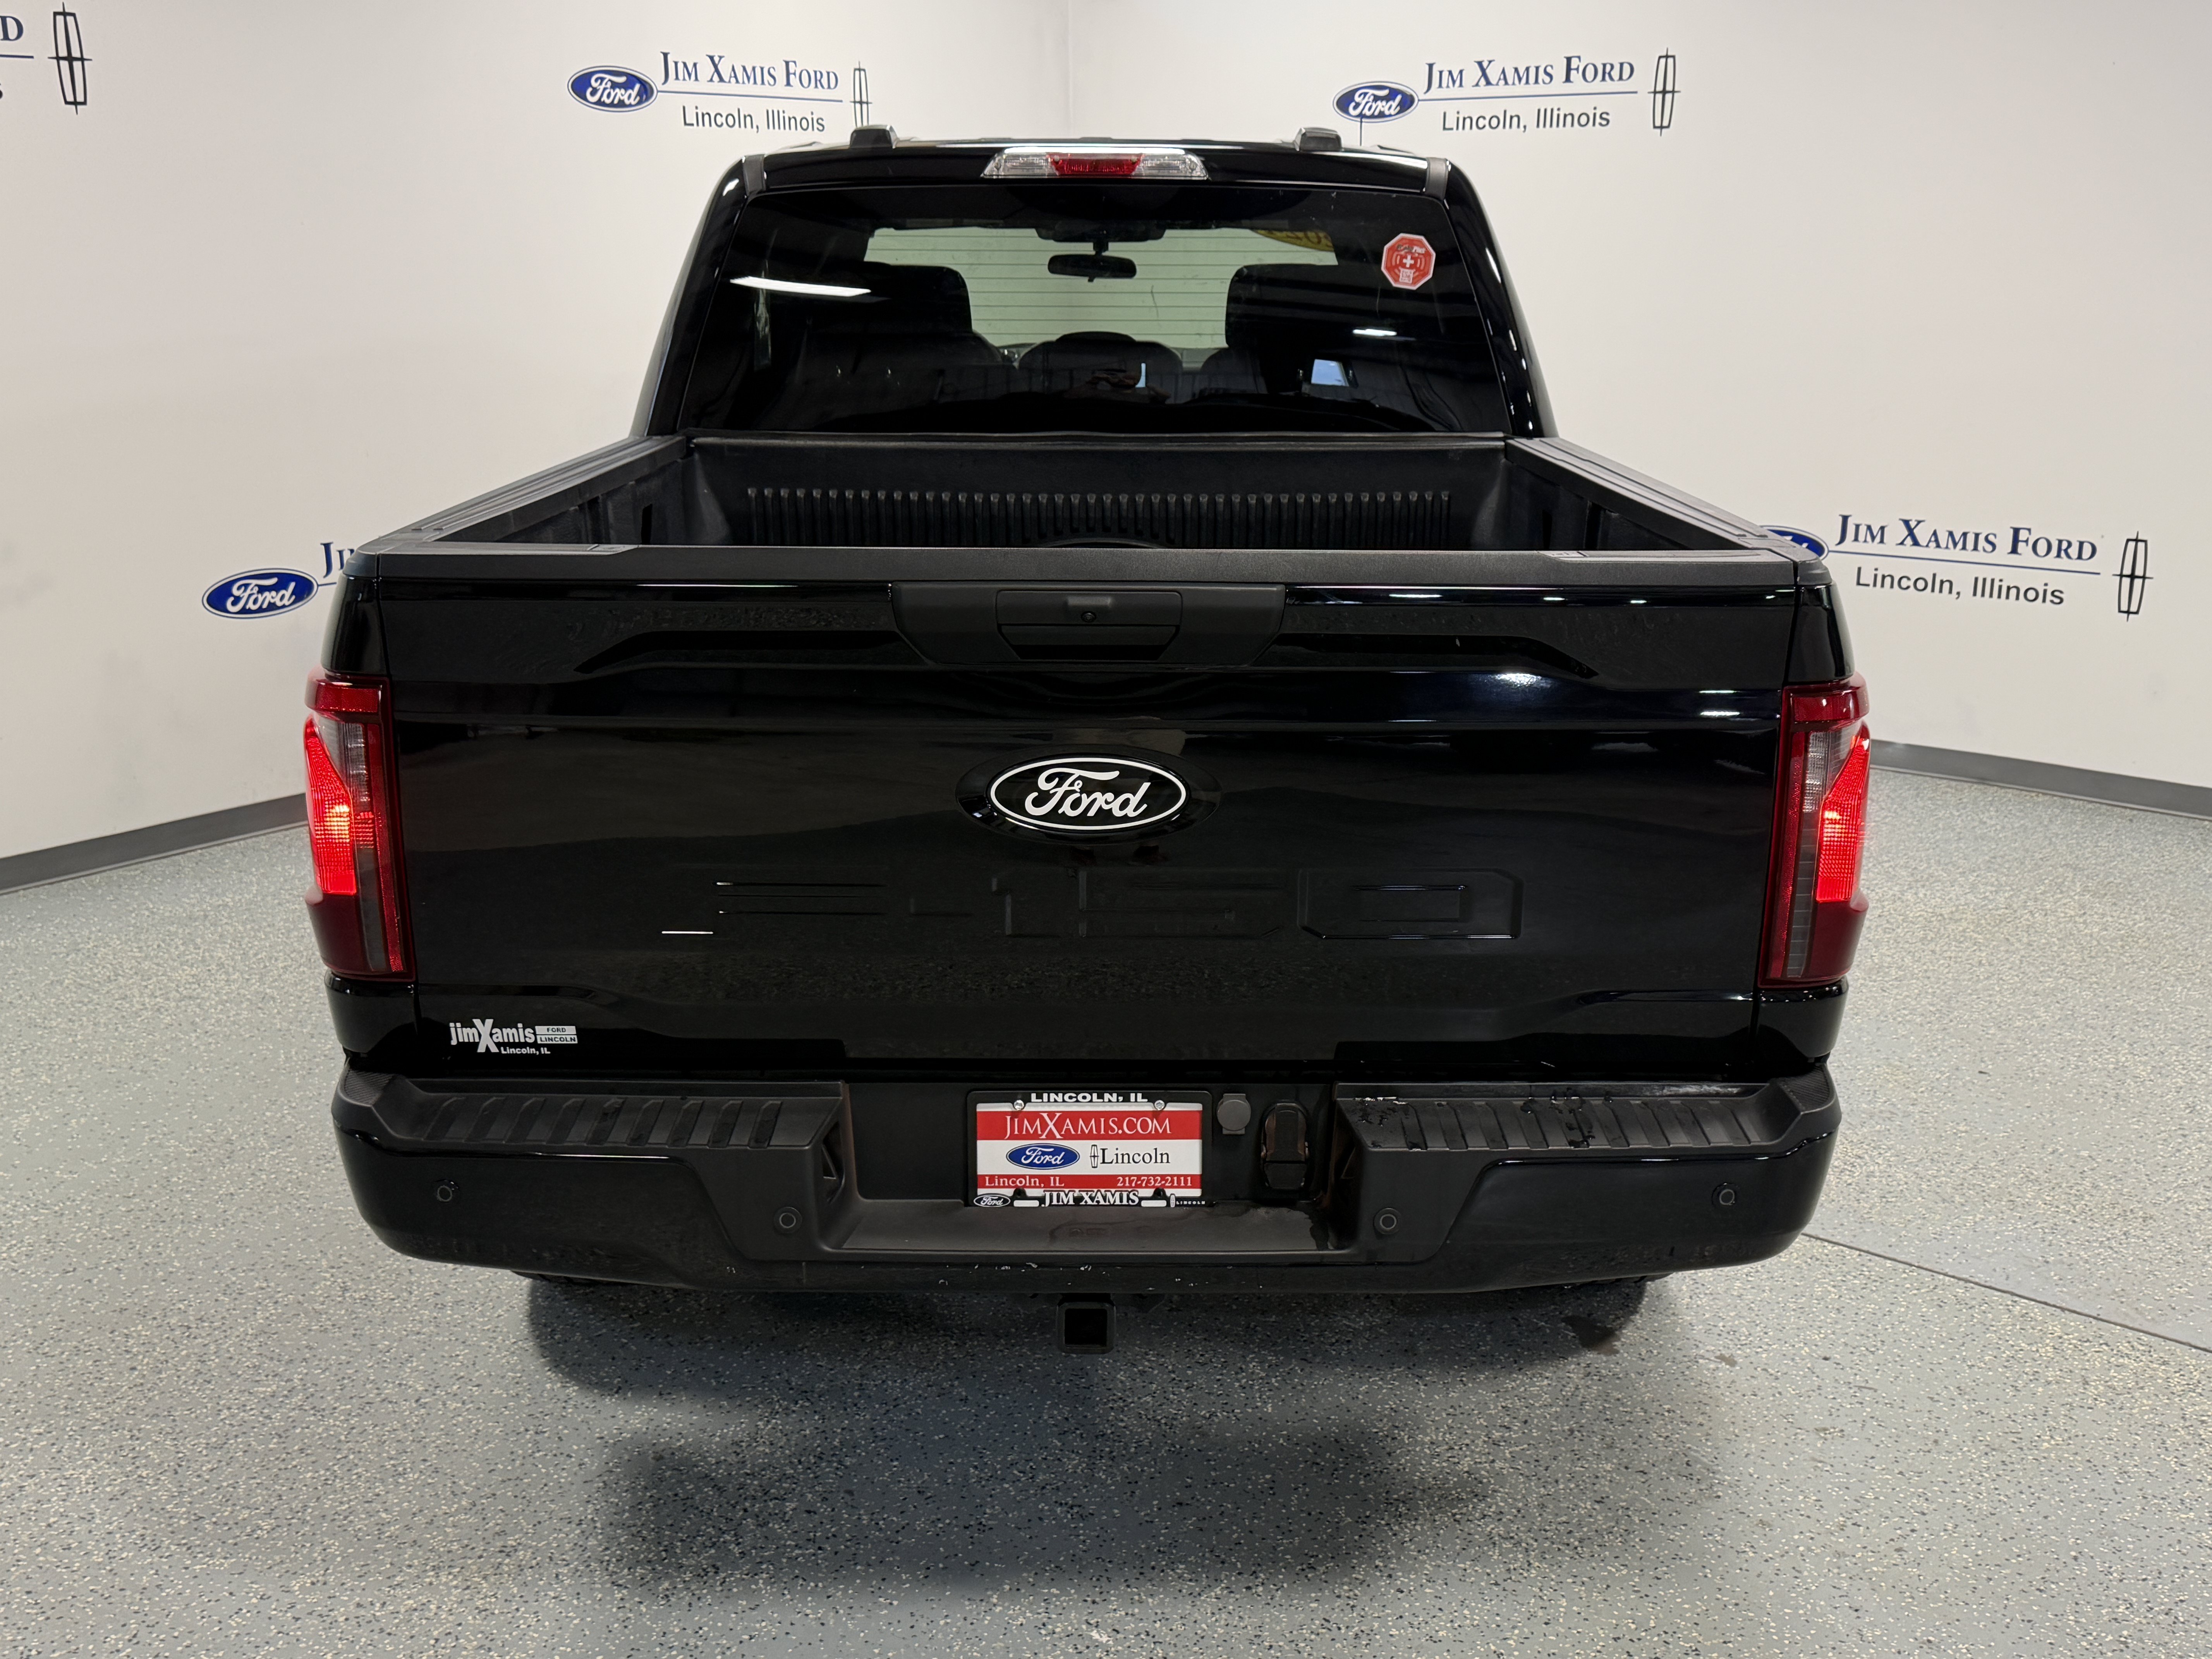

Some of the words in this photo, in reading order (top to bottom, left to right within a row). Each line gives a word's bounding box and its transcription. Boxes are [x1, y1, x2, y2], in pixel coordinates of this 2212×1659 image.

[660, 51, 699, 85] JIM
[706, 54, 776, 86] XAMIS
[783, 59, 839, 89] FORD
[1423, 62, 1465, 94] JIM
[1472, 59, 1554, 87] XAMIS
[1562, 55, 1635, 84] FORD
[586, 72, 640, 105] Ford
[1348, 88, 1400, 116] Ford
[682, 105, 759, 133] Lincoln,
[766, 109, 825, 132] Illinois
[1442, 110, 1527, 132] Lincoln,
[1536, 106, 1610, 128] Illinois
[1835, 514, 1888, 546] JIM
[1896, 518, 1997, 553] XAMIS
[2007, 526, 2097, 561] FORD
[320, 541, 355, 579] JI
[226, 577, 296, 613] Ford
[1856, 566, 1960, 599] Lincoln,
[1972, 576, 2064, 605] Illinois
[1025, 767, 1151, 817] Ford
[501, 1046, 539, 1055] Lincoln,
[1031, 1093, 1123, 1103] LINCOLN,
[1130, 1093, 1148, 1103] IL
[1021, 1147, 1065, 1165] Ford
[1100, 1147, 1171, 1164] Lincoln
[985, 1175, 1044, 1187] Lincoln,
[1050, 1176, 1065, 1186] IL
[1117, 1176, 1192, 1187] 217-732-2111
[980, 1196, 1004, 1206] Ford
[1041, 1191, 1075, 1207] JIM
[1080, 1191, 1139, 1206] XAMIS
